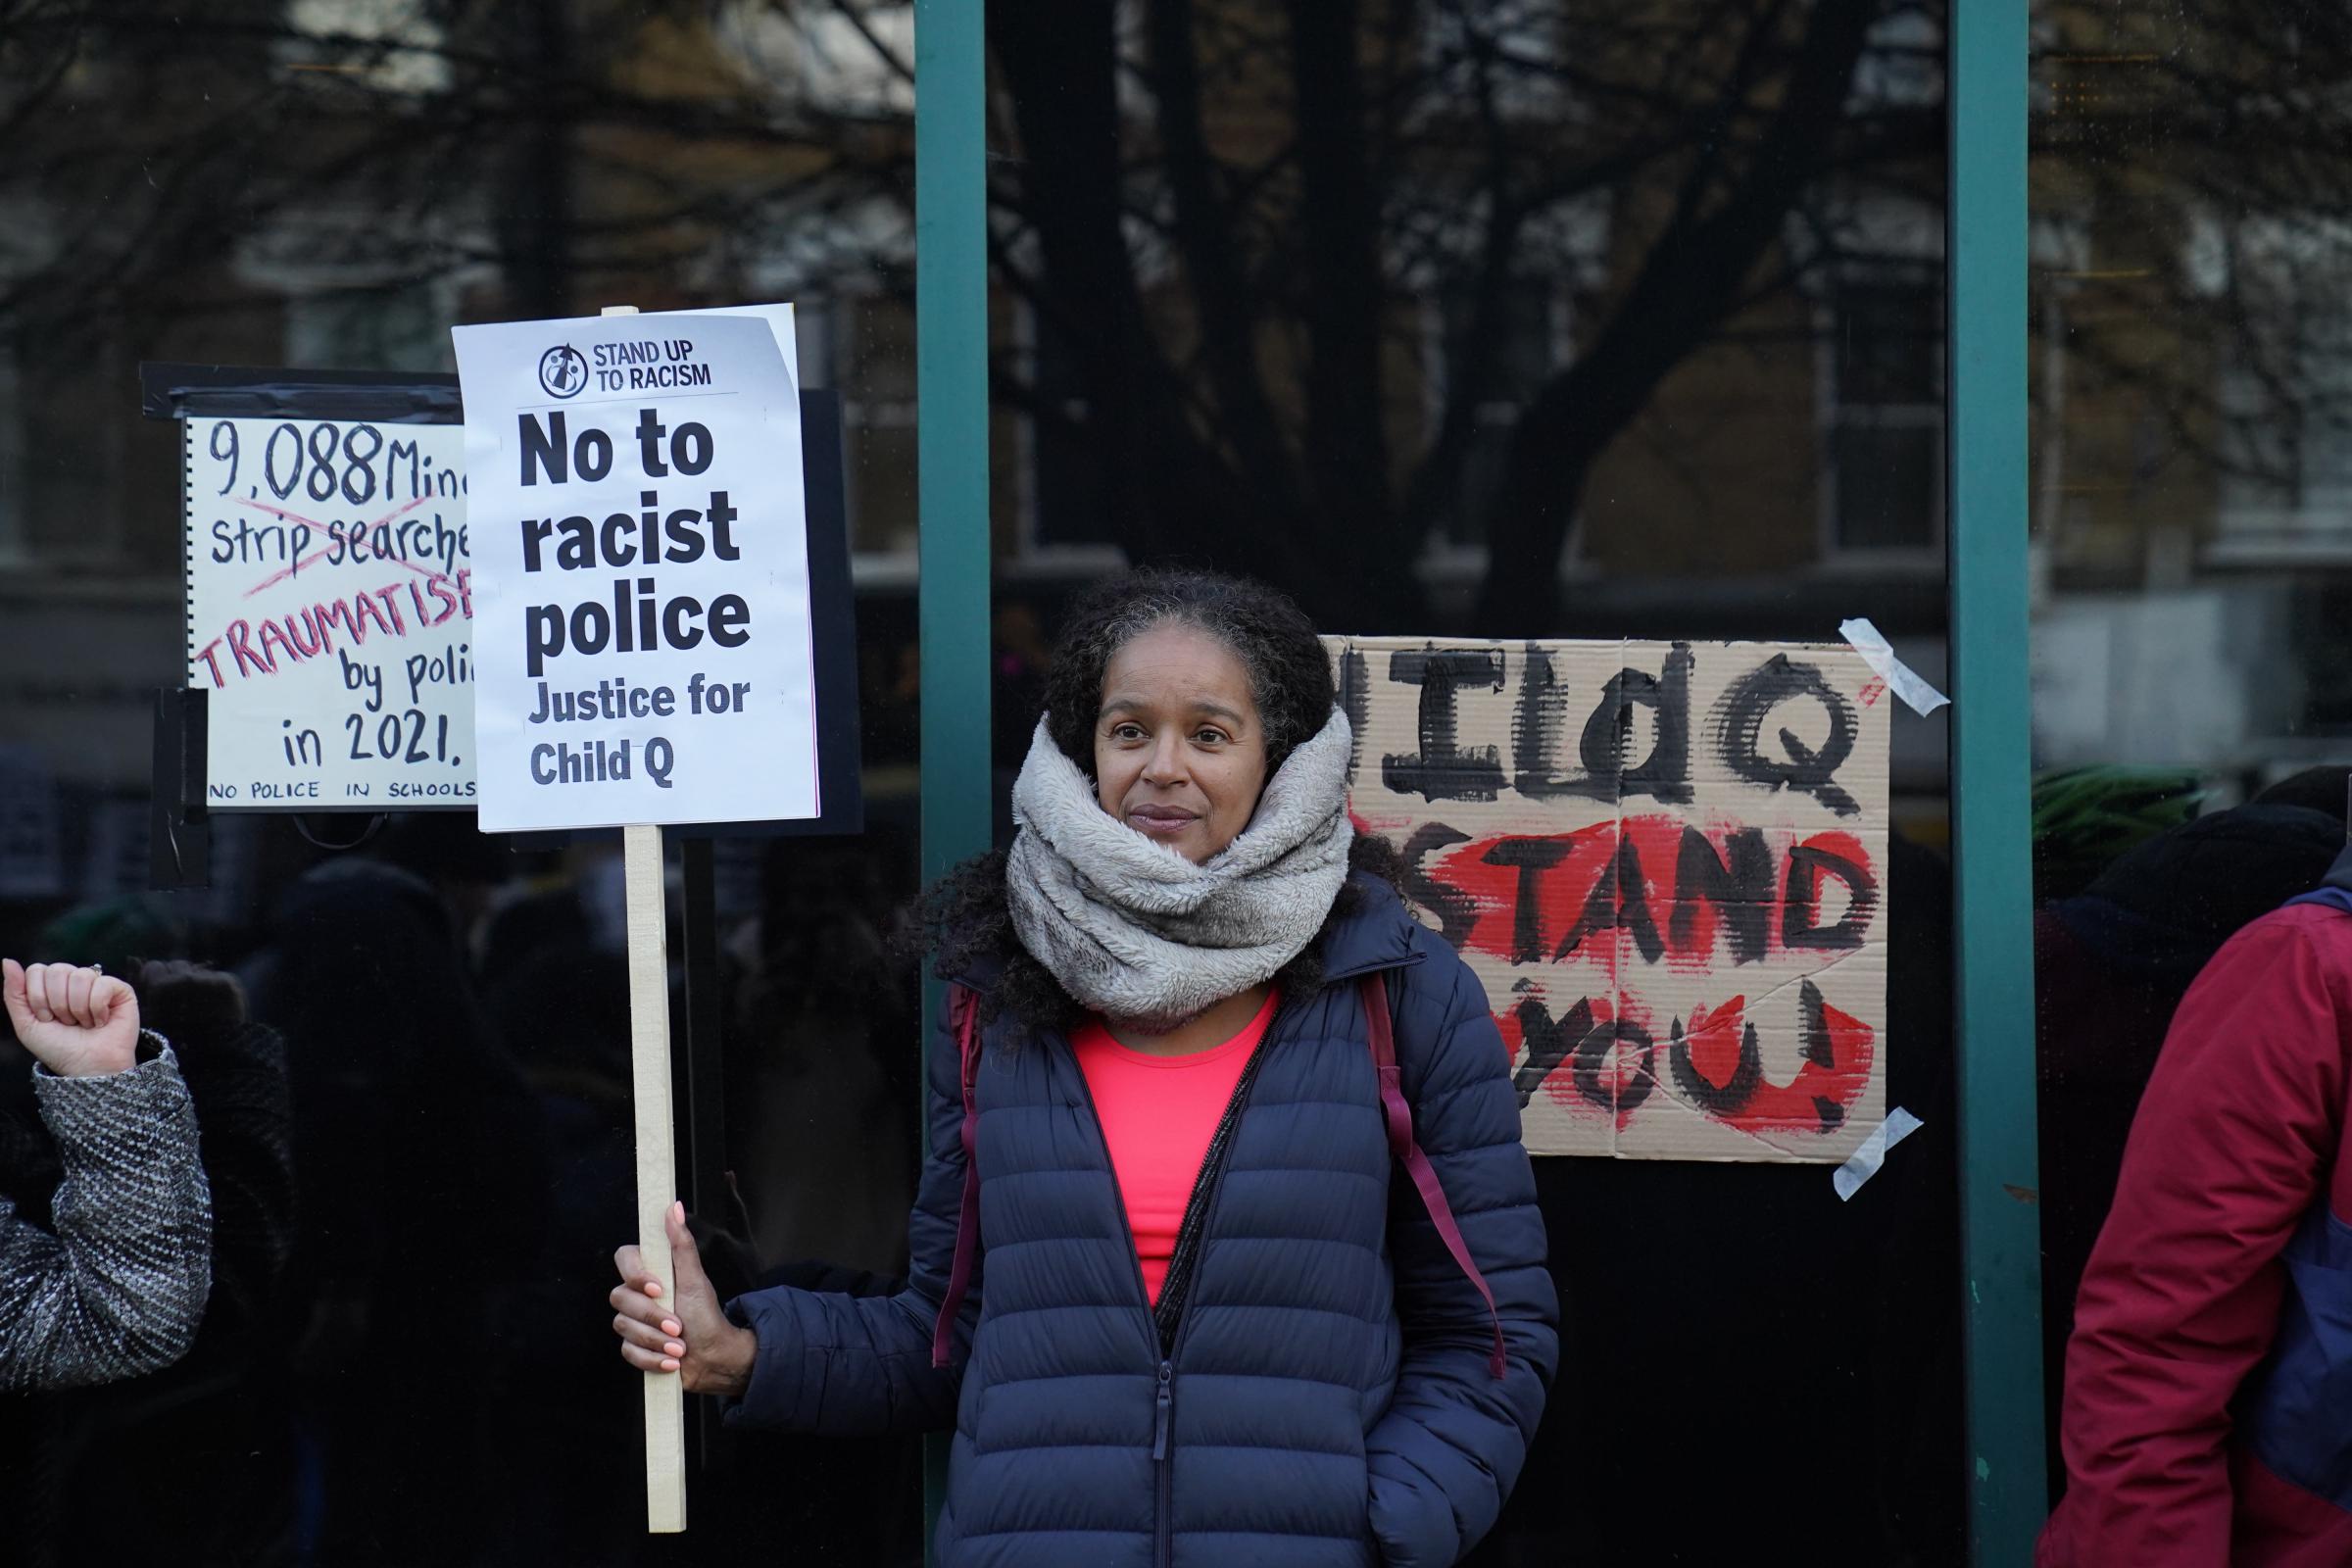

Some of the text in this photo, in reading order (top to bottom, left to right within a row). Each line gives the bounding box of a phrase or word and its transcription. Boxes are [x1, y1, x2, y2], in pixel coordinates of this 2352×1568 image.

[593, 340, 693, 367] STAND UP
[596, 364, 711, 392] TO RACISM
[209, 420, 383, 506] 9,088
[517, 408, 714, 487] No to
[325, 513, 470, 575] searche
[520, 490, 740, 573] racist
[525, 577, 751, 678] police
[339, 643, 474, 712] by poli
[527, 672, 751, 724] Justice for
[282, 709, 461, 766] in 2021.
[530, 736, 674, 789] Child Q
[1701, 653, 1860, 816] Q
[209, 781, 476, 799] NO POLICE IN SCHOOLS
[1401, 821, 1881, 966] STAND
